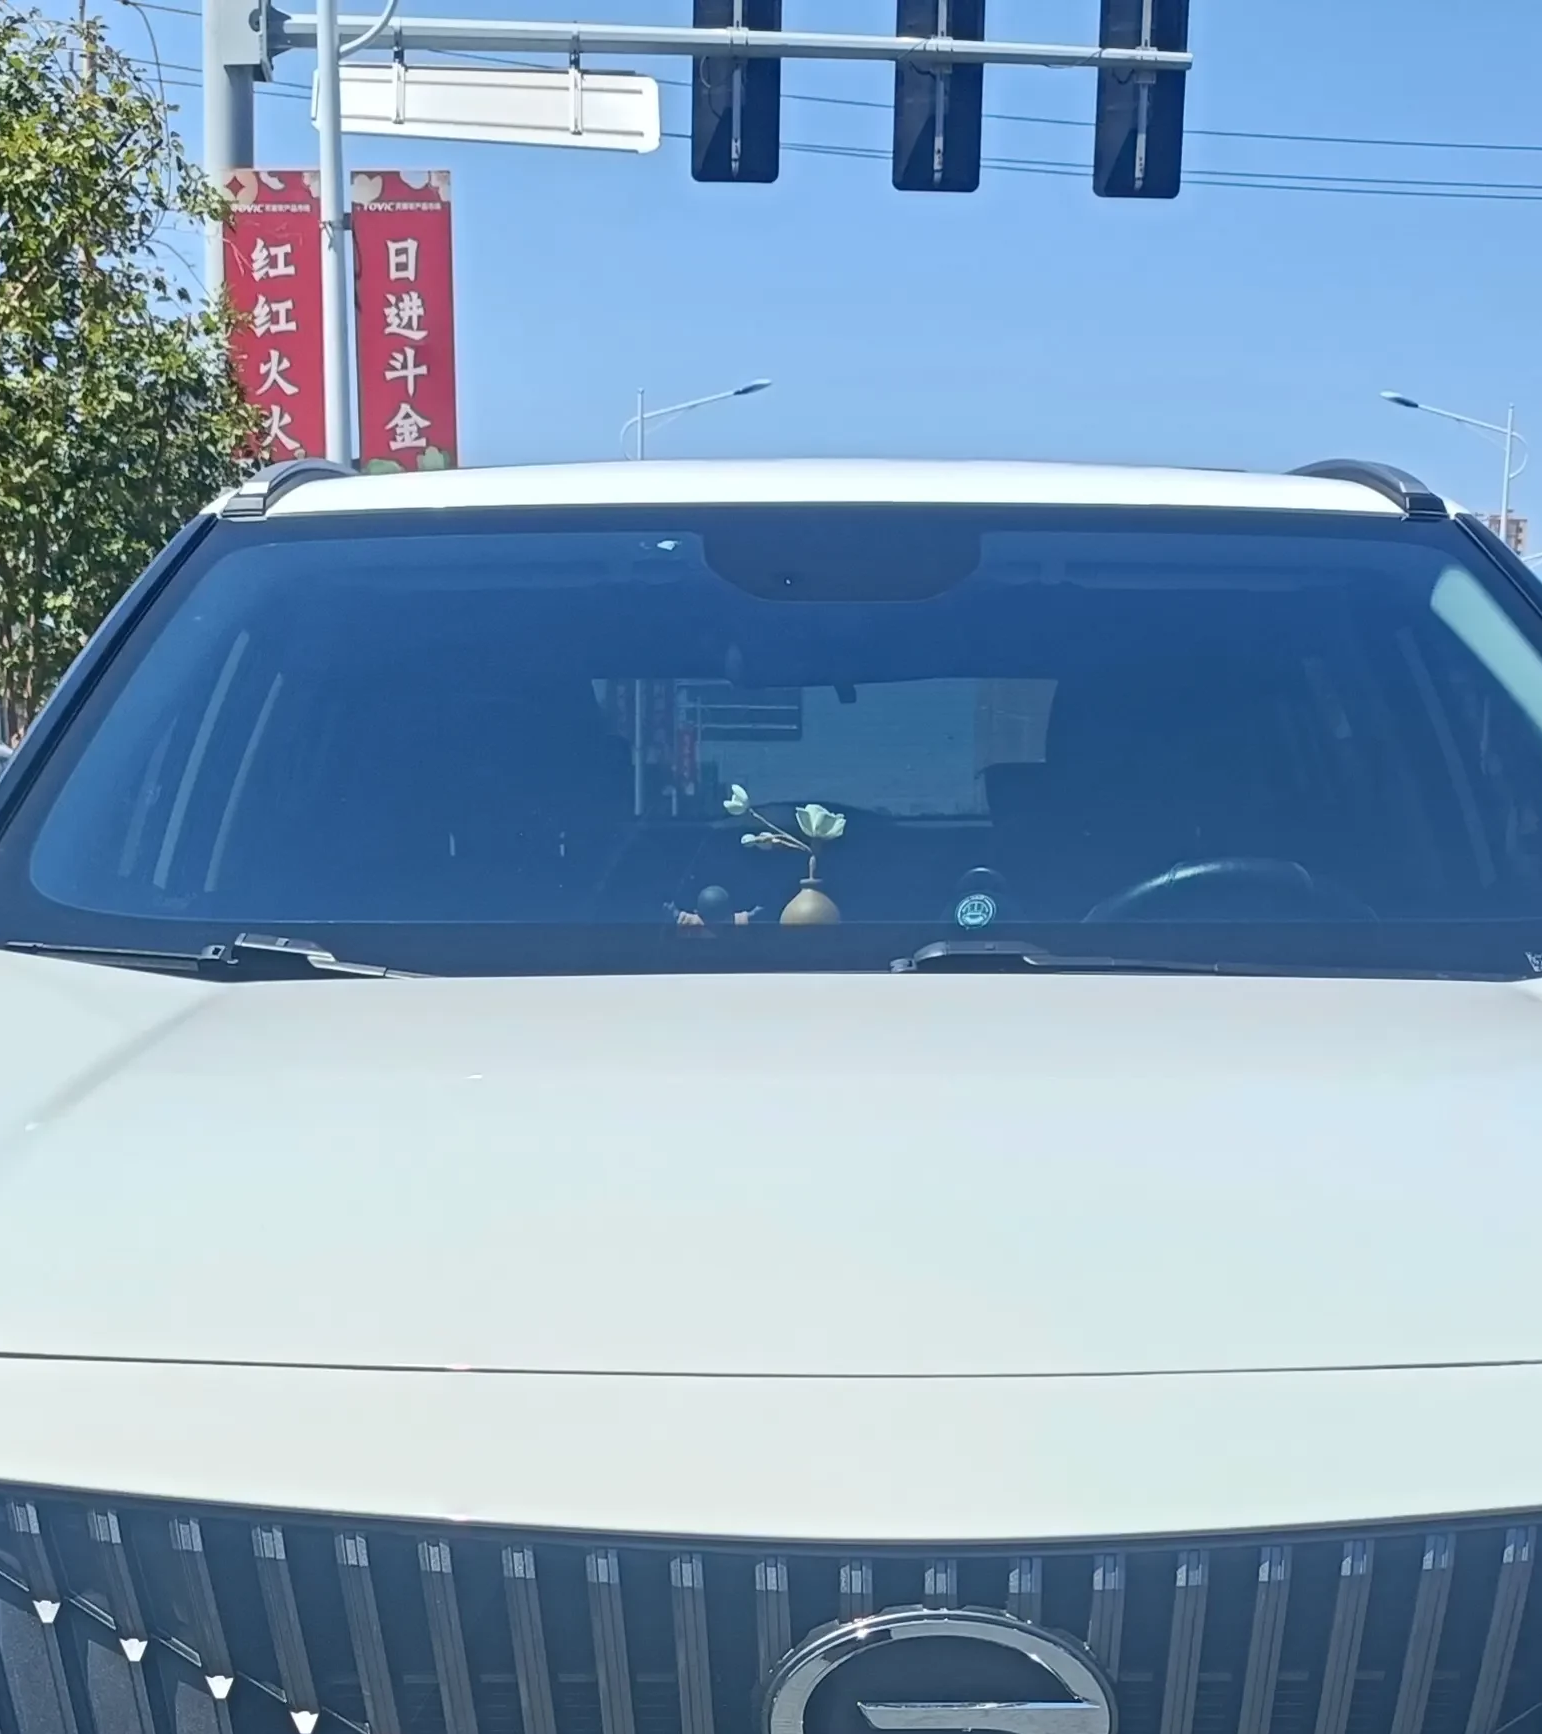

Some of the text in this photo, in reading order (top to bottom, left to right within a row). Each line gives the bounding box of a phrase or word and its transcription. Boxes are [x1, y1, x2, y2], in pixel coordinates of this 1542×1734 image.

[251, 237, 302, 450] 红红火火
[383, 237, 432, 451] 日进斗金
